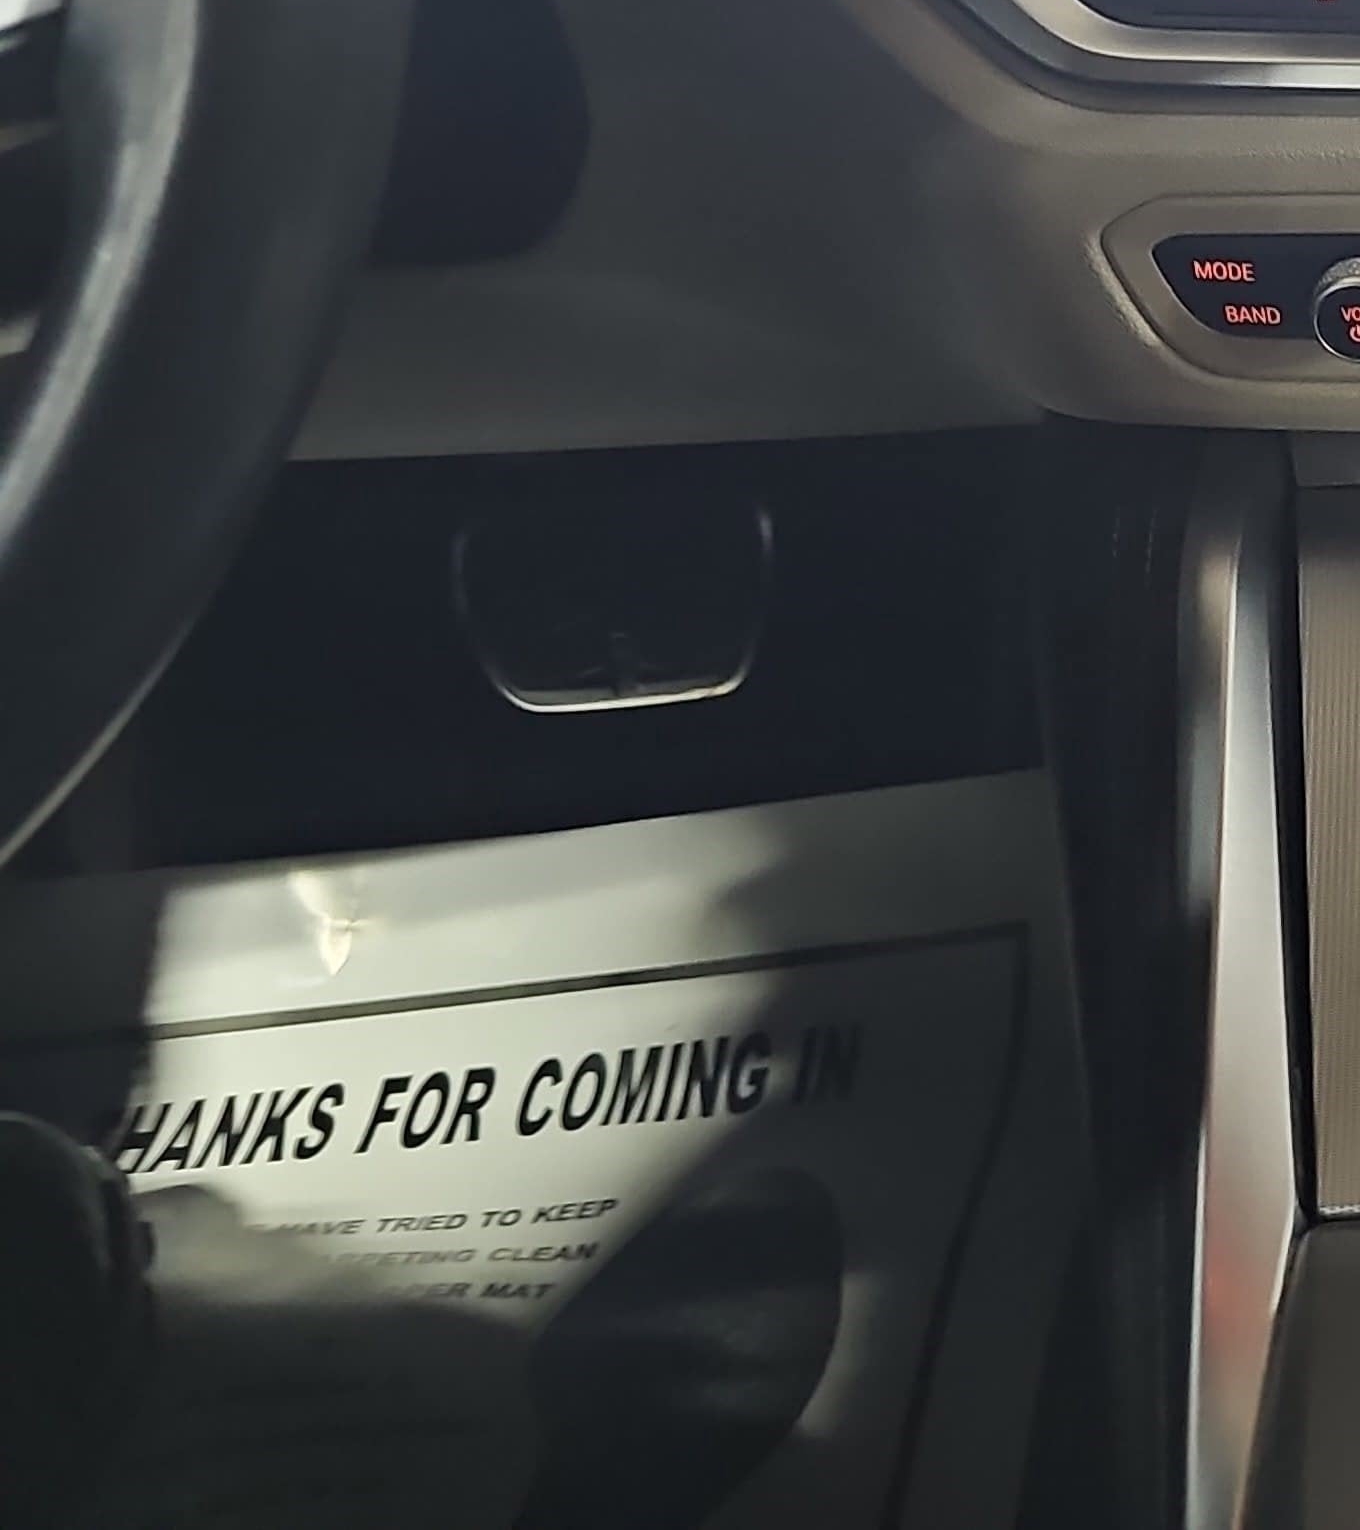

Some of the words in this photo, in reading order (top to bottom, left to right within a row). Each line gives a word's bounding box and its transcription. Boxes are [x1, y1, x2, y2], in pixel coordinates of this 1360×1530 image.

[1193, 260, 1255, 282] MODE
[1225, 304, 1281, 325] BAND
[111, 1082, 344, 1174] HANKS
[353, 1066, 496, 1154] FOR
[516, 1031, 771, 1137] COMING
[792, 1025, 864, 1104] IN
[376, 1213, 468, 1234] TRIED
[481, 1209, 523, 1228] TO
[531, 1198, 619, 1224] KEEP
[488, 1242, 599, 1263] CLEAN
[480, 1282, 555, 1300] MAT
